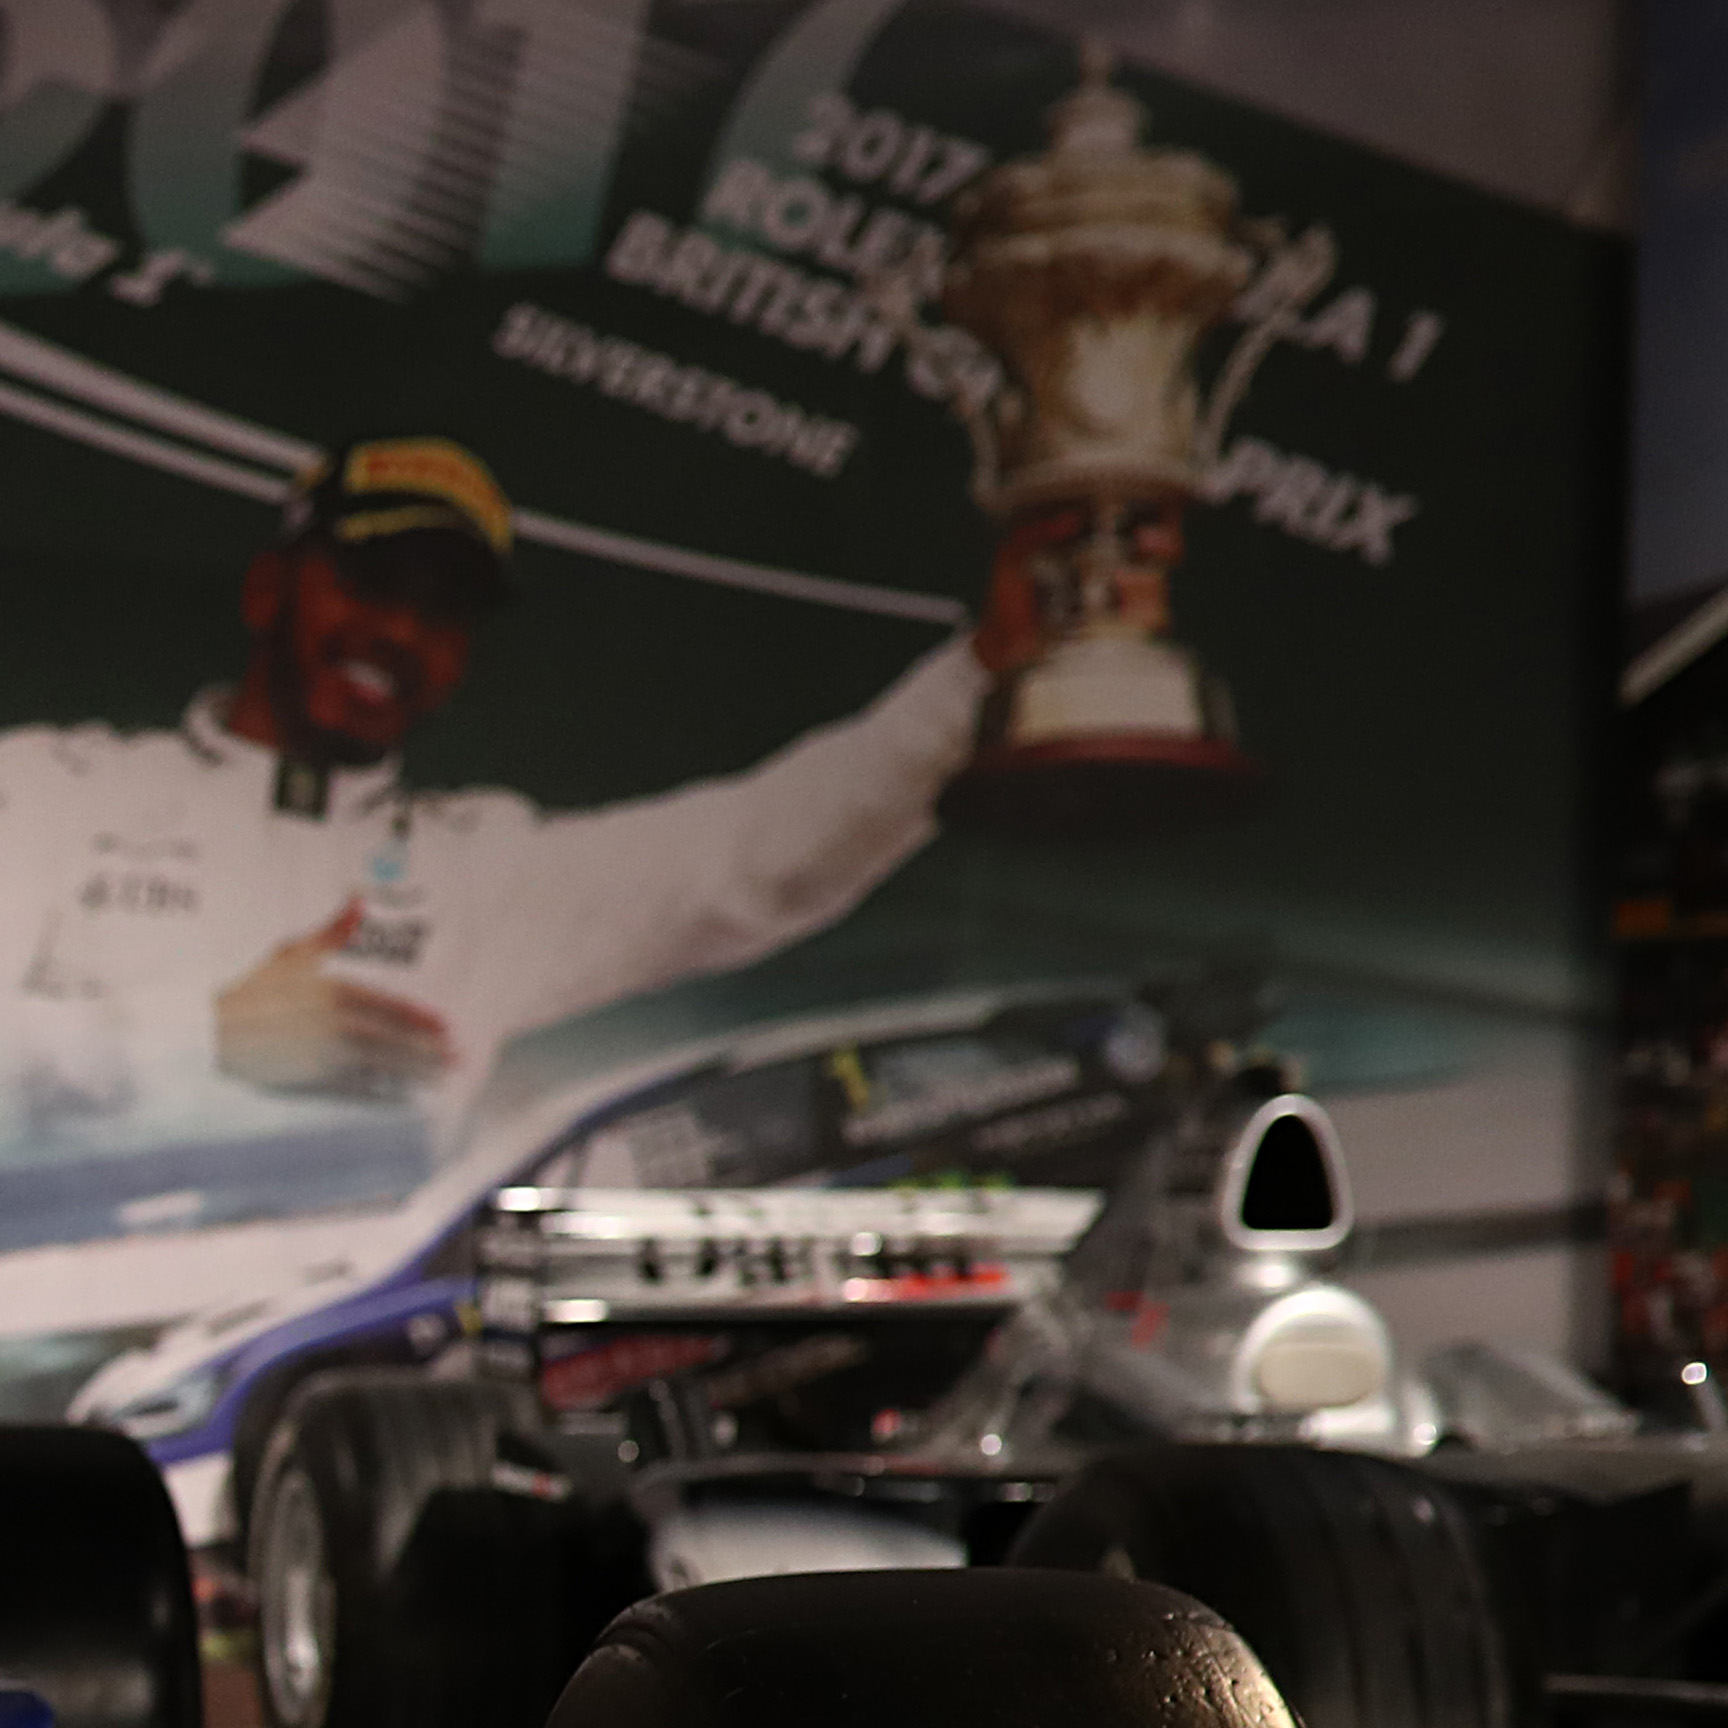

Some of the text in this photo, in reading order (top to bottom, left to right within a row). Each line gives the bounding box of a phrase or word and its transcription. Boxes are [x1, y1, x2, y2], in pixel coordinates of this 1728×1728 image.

[706, 157, 951, 297] ROLEX
[801, 90, 992, 203] 2017
[490, 298, 862, 480] SILVERSTONE
[605, 208, 901, 378] BRITISH
[1206, 434, 1420, 570] PRIX
